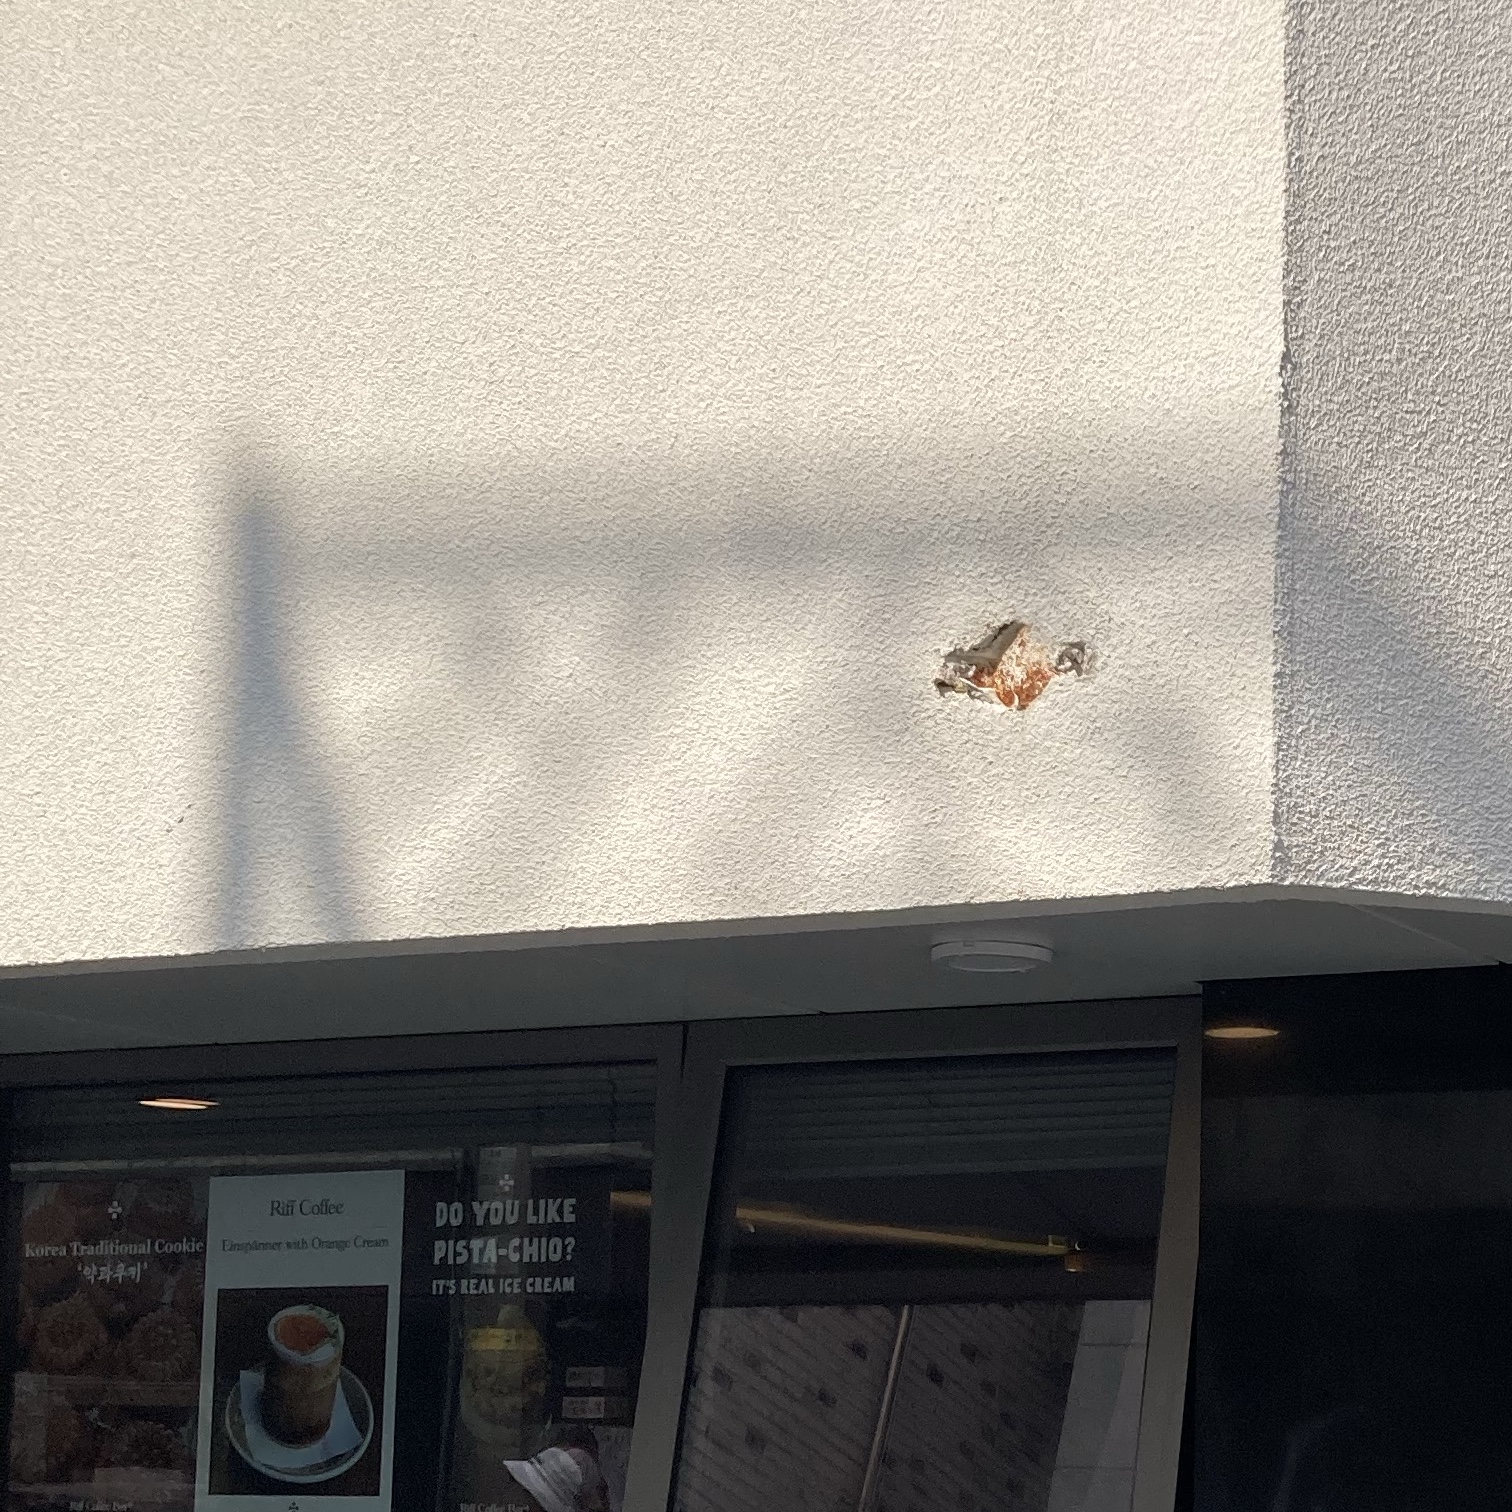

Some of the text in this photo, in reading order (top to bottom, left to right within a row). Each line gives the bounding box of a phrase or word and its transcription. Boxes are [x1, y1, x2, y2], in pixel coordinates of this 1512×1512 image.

[299, 1198, 344, 1216] Coffee
[435, 1197, 577, 1228] DO YOU LIKE
[24, 1235, 205, 1258] Korea Traditional Cookie
[286, 1237, 308, 1251] with
[311, 1235, 350, 1252] Orange
[353, 1235, 389, 1249] Cream
[432, 1236, 577, 1266] PISTA-CHIO?
[431, 1275, 576, 1296] IT'S REAL ICE CREAM
